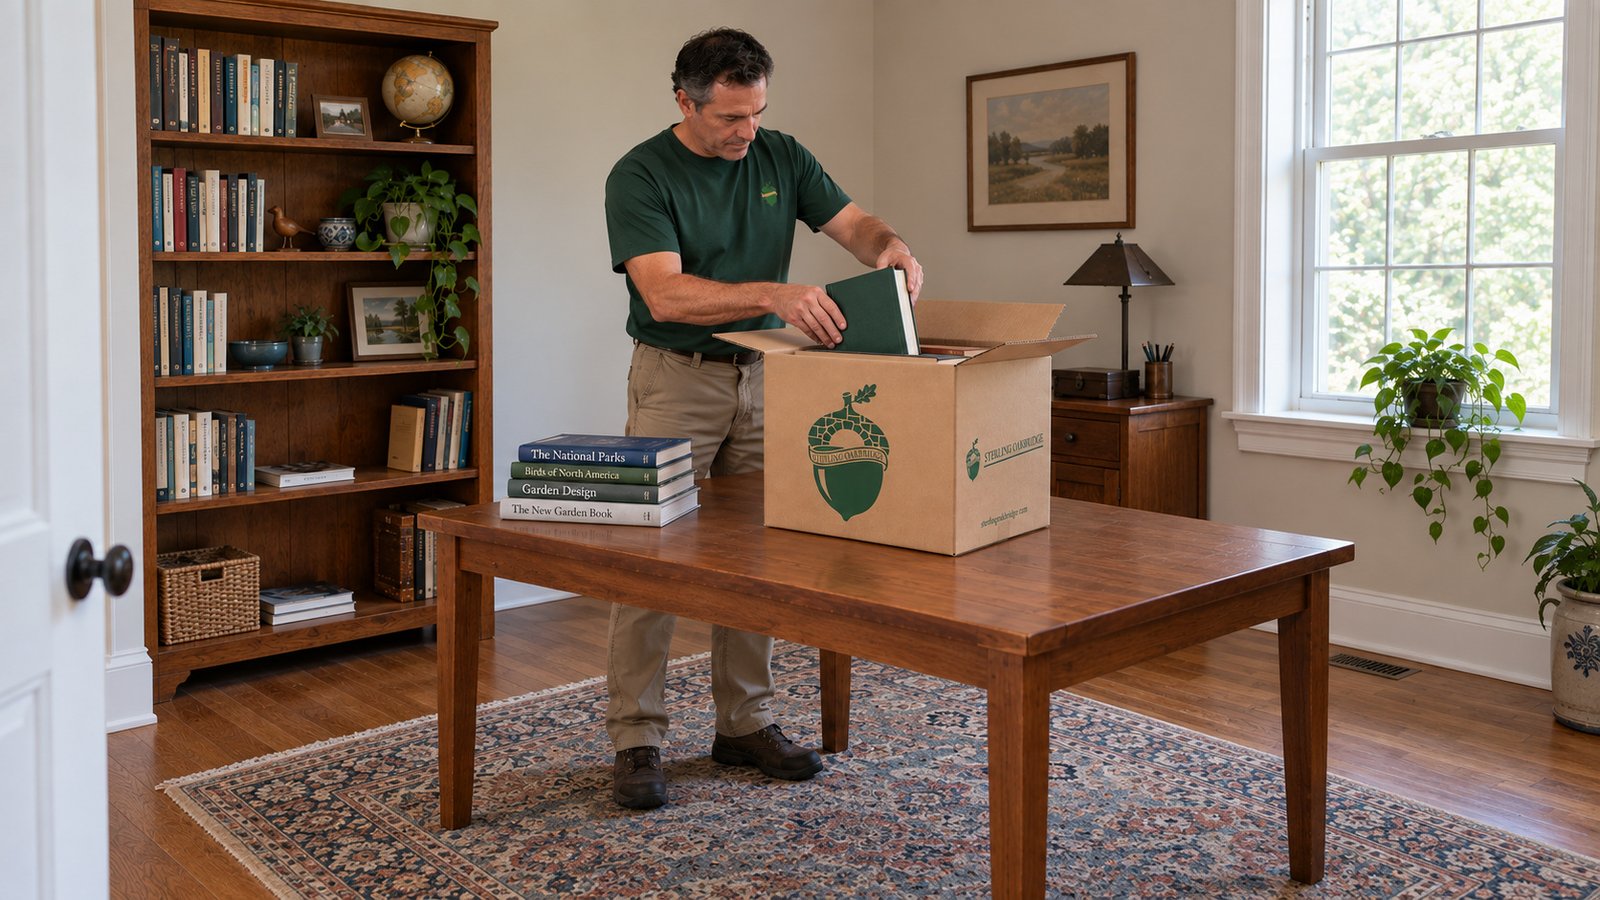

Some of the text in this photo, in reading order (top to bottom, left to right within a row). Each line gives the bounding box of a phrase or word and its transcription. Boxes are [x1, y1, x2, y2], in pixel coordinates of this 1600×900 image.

[531, 449, 626, 463] The National Parks
[525, 467, 620, 480] Birds of North America
[522, 483, 597, 500] Garden Design
[511, 504, 613, 519] The New Garden Book
